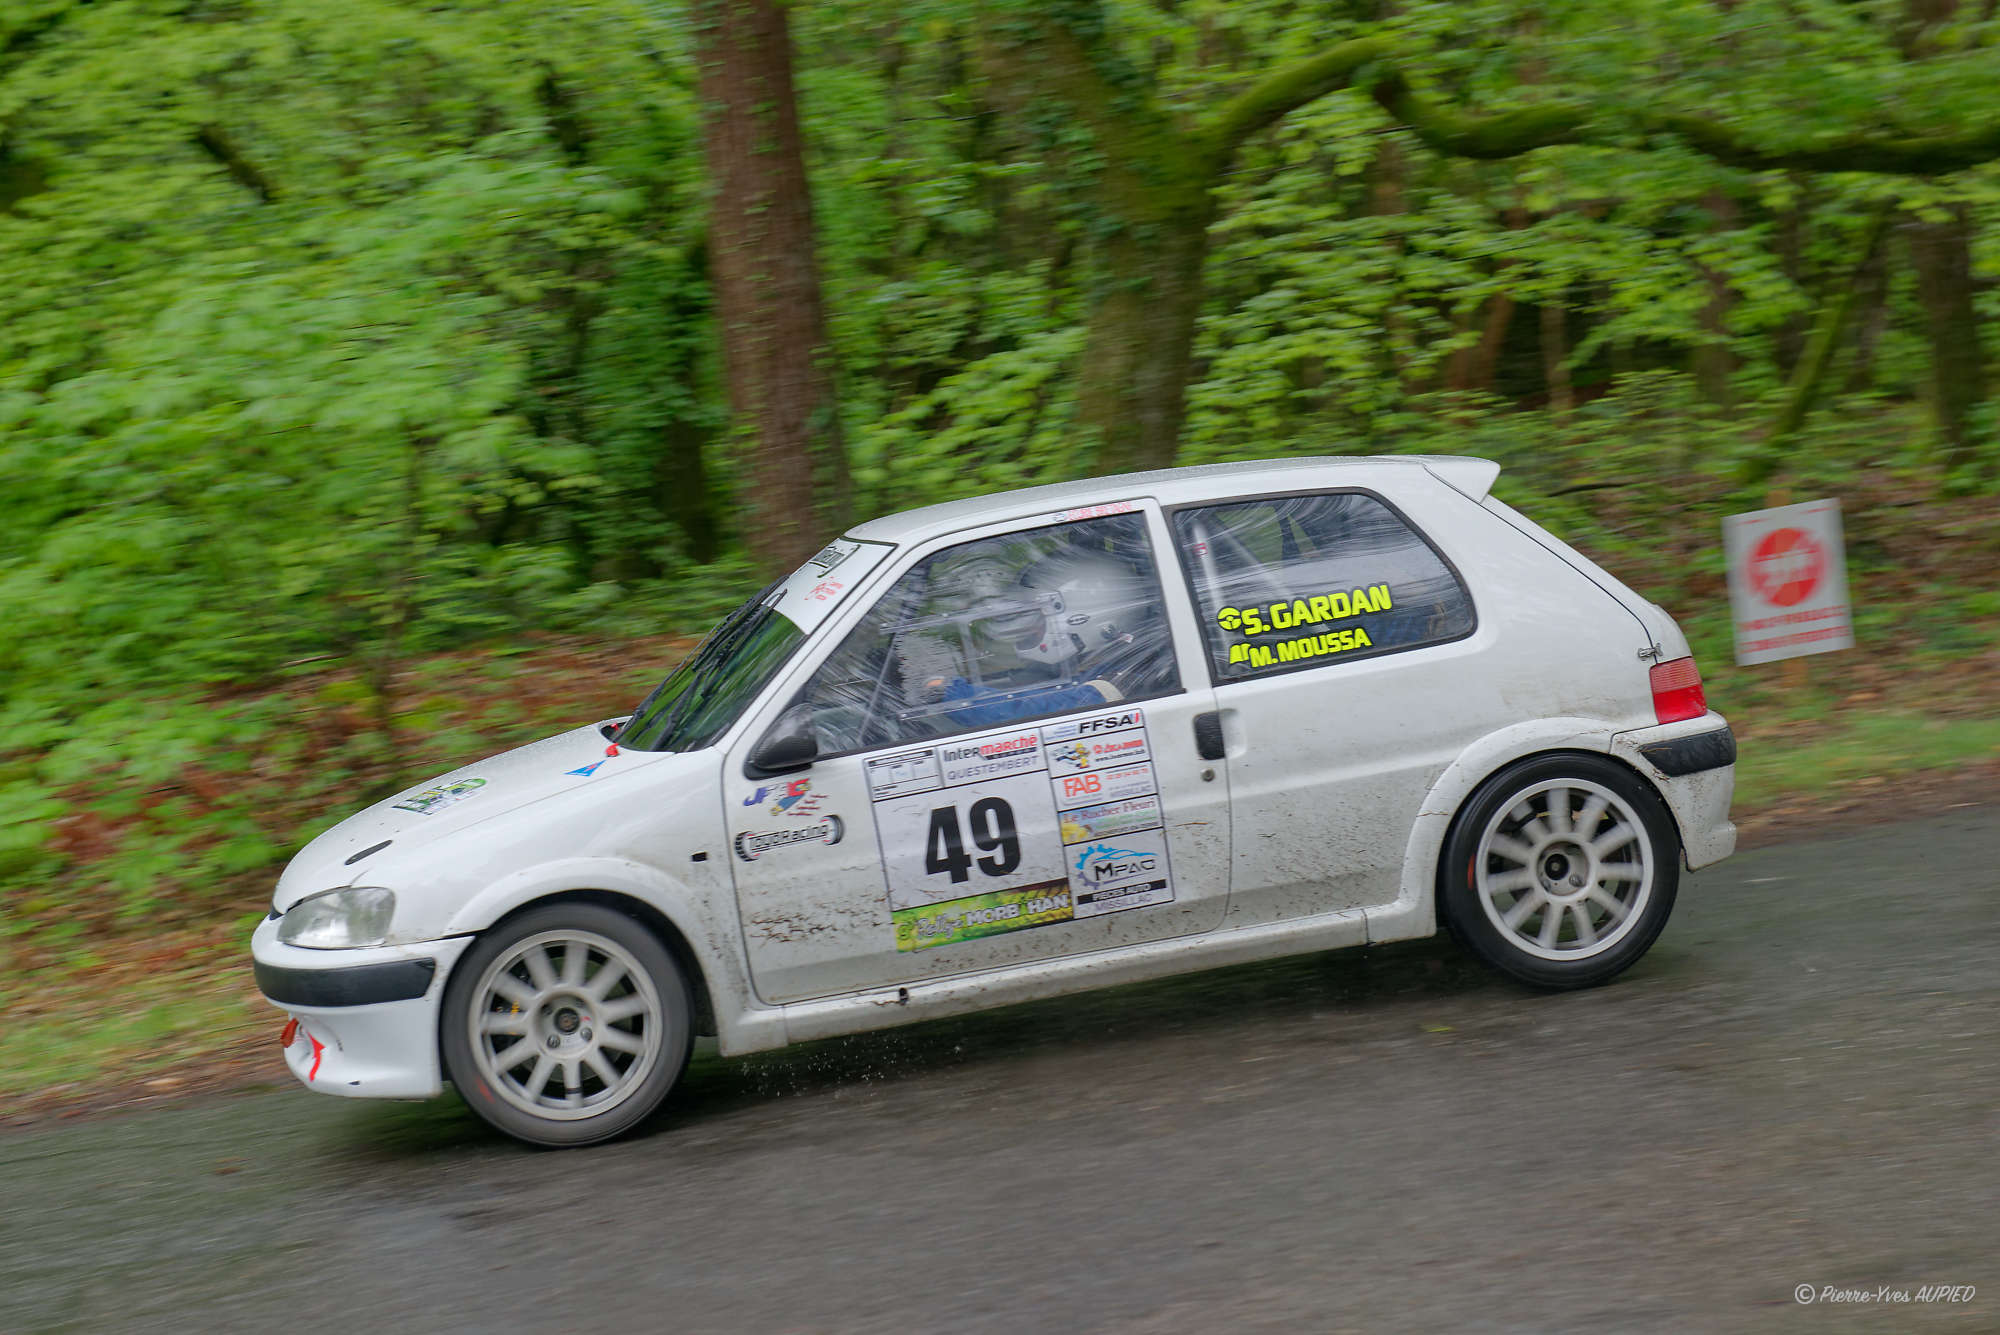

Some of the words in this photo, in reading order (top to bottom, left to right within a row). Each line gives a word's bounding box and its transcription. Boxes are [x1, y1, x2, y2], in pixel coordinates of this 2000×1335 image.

[1242, 585, 1393, 635] S.GARDAN
[1249, 628, 1373, 667] M.MOUSSA
[1080, 714, 1133, 733] FFSA
[947, 755, 1038, 781] QUESTEMBERT
[1063, 773, 1102, 797] FAB
[926, 797, 1021, 883] 49
